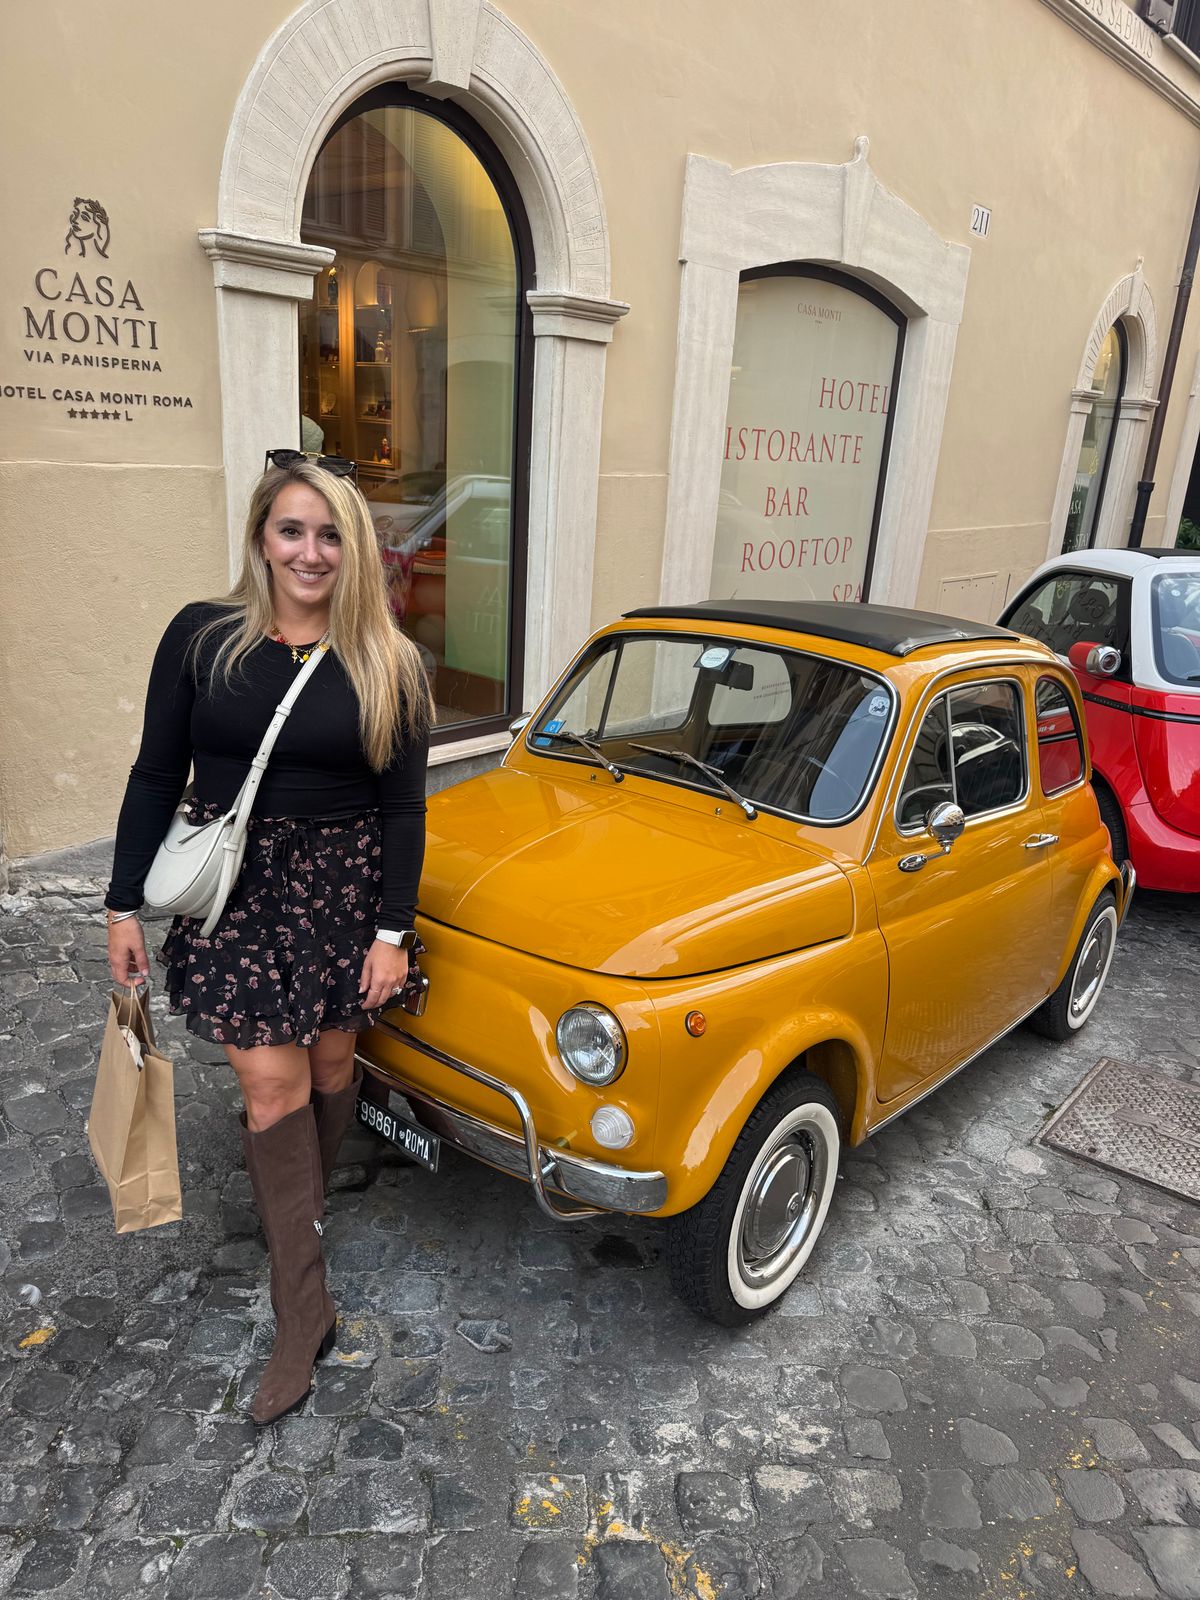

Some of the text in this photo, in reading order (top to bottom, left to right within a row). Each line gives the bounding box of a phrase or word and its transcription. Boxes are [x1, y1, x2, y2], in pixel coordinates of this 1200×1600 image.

[972, 207, 990, 235] 211
[35, 268, 145, 311] CASA
[797, 302, 842, 321] CASA MONTI
[23, 306, 159, 350] MONTI
[24, 349, 162, 372] VIA PANISPERNA
[52, 388, 95, 403] CASA
[100, 391, 147, 406] MONTI
[153, 395, 193, 408] ROMA
[818, 377, 889, 415] HOTEL
[764, 486, 810, 517] BAR
[741, 536, 853, 572] ROOFTOP
[832, 583, 862, 603] SPA
[404, 1128, 429, 1161] ROMA
